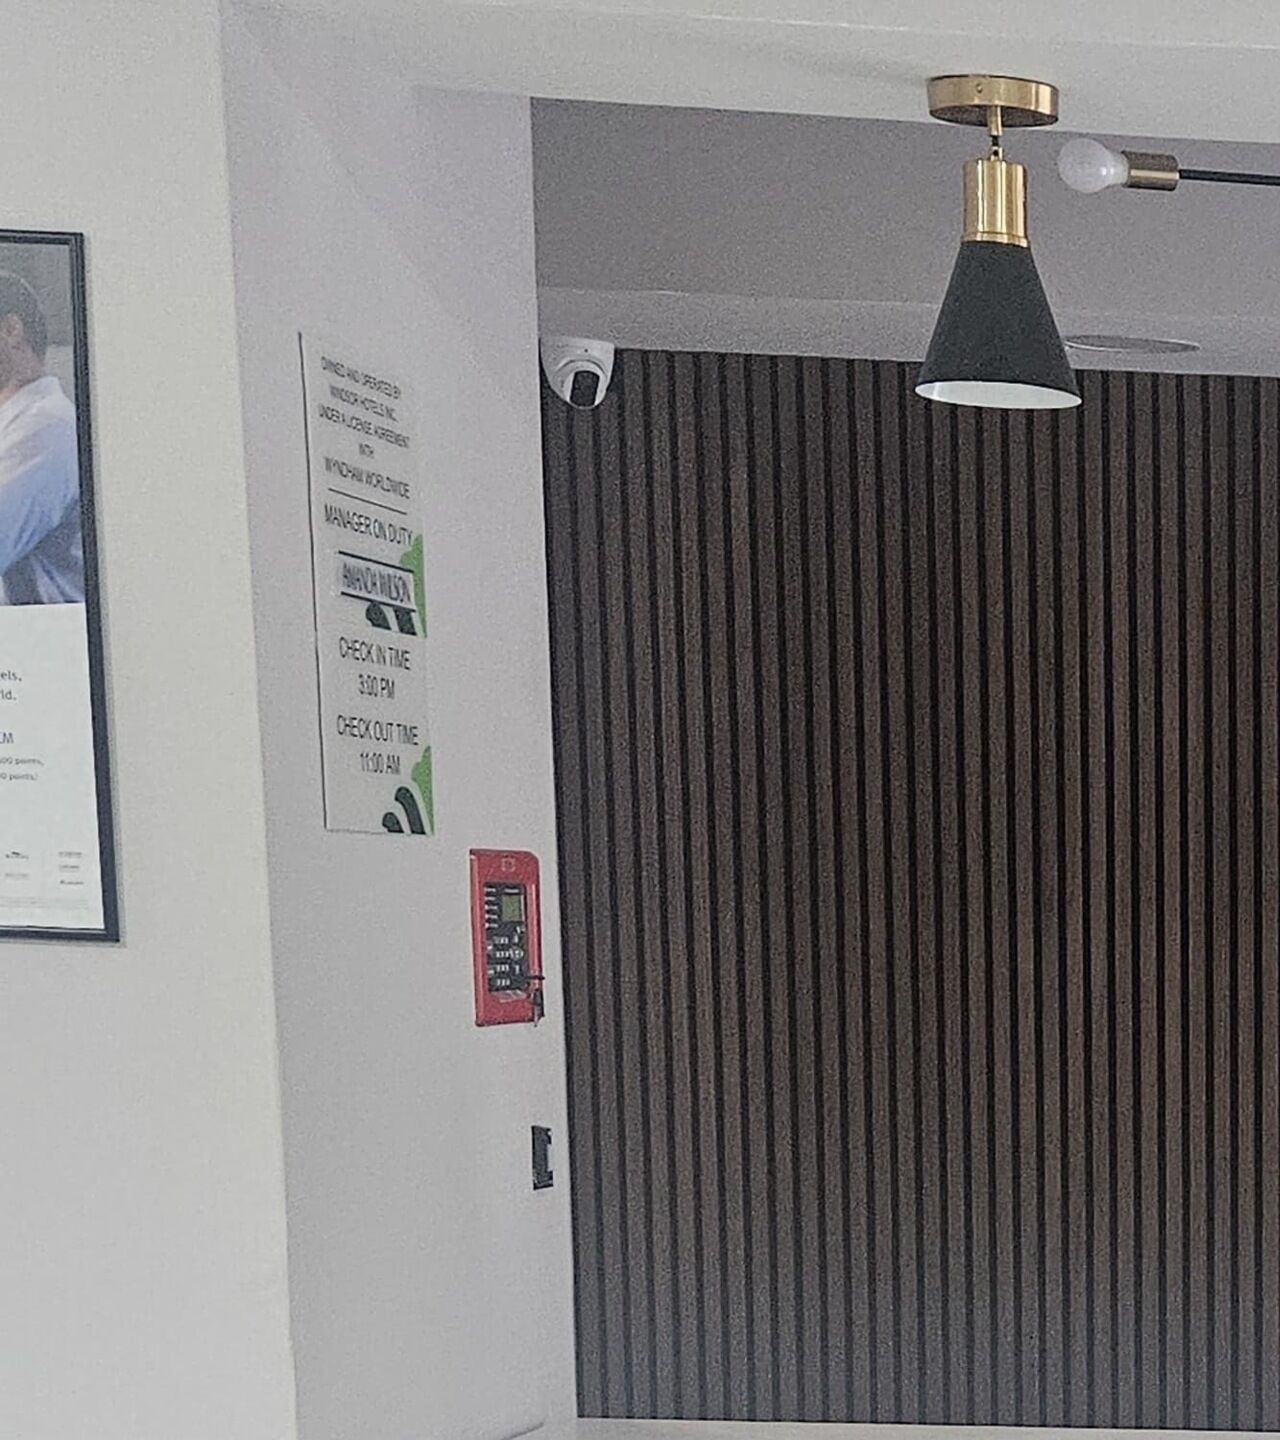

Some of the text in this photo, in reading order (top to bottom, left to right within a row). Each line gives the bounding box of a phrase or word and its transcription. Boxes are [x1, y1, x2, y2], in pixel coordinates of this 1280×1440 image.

[324, 503, 412, 547] MANAGER ON DUTY
[339, 637, 411, 670] CHECK IN TIME
[380, 678, 395, 699] PM
[337, 715, 419, 745] CHECK OUT TIME
[385, 755, 401, 775] AM
